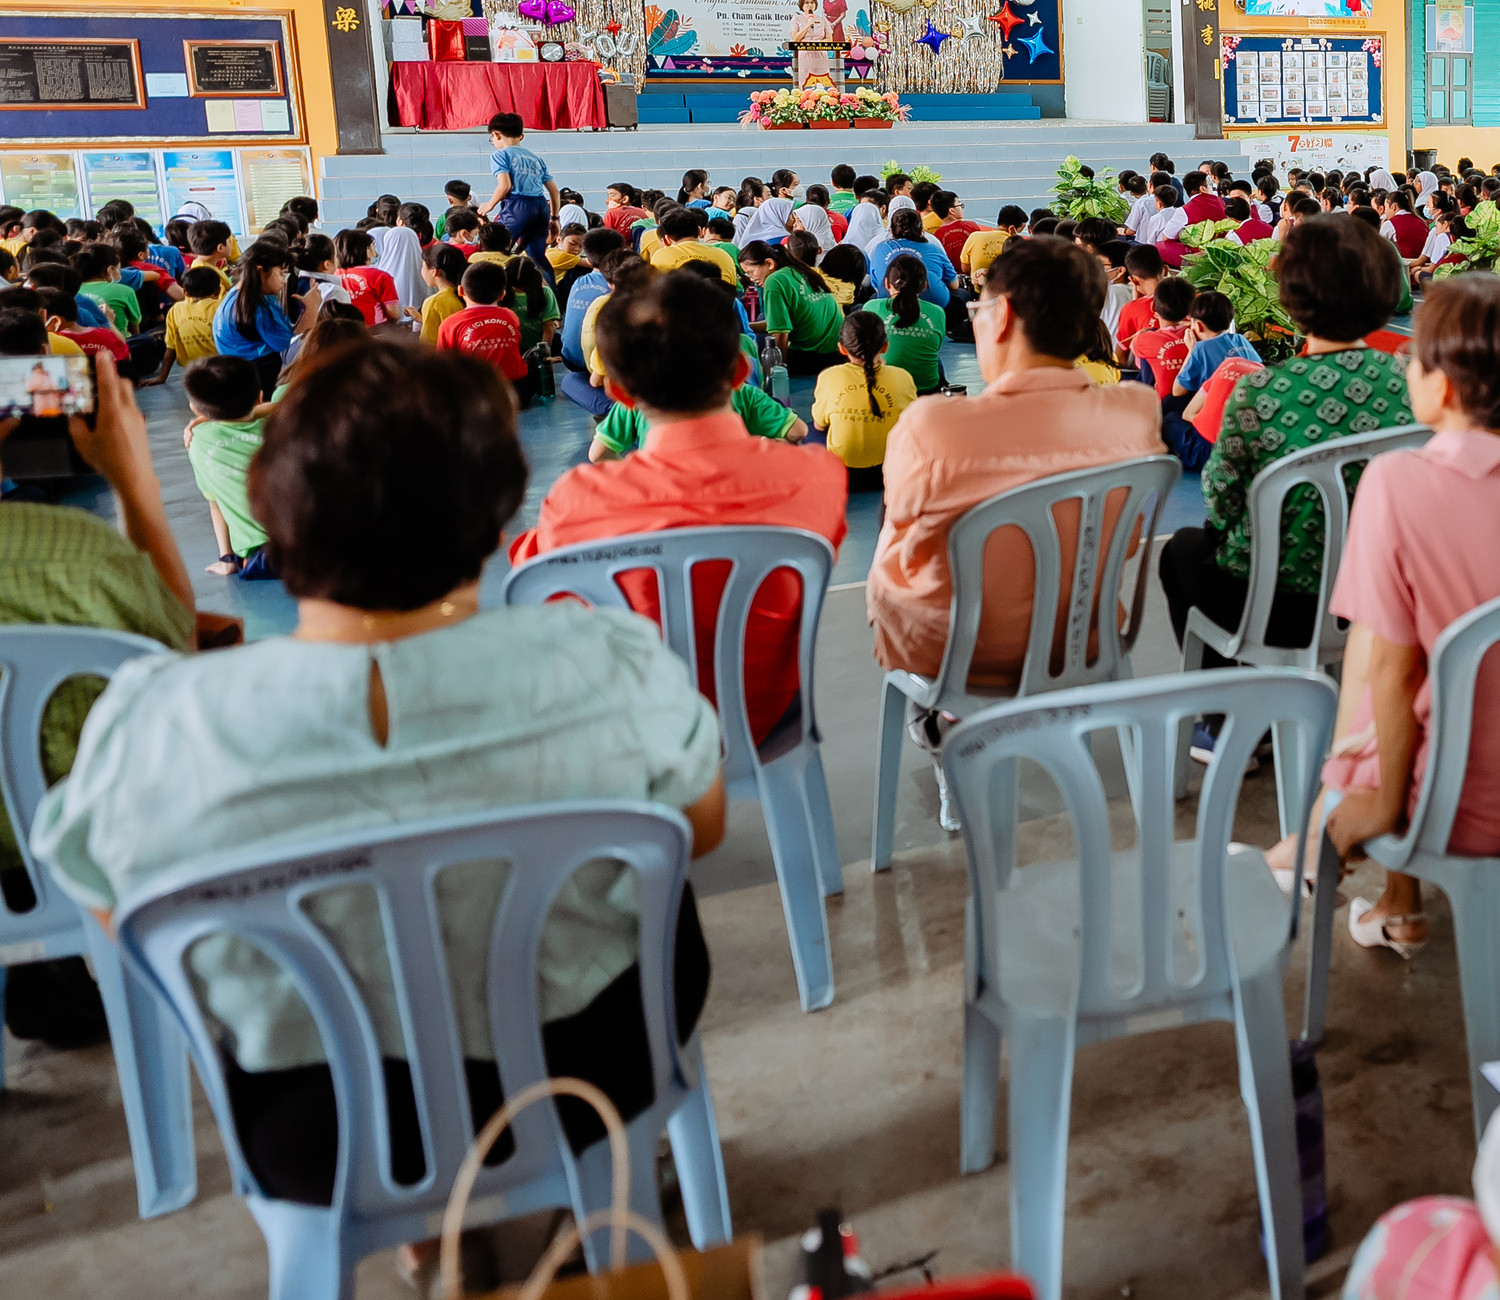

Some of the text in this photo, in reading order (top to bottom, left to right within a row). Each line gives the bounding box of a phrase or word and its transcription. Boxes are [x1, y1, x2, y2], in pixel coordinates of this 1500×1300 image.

[732, 12, 753, 20] Cham
[755, 12, 772, 20] Gaik
[577, 22, 639, 59] YOU
[463, 327, 475, 342] SJK
[484, 318, 508, 327] KONG
[885, 392, 895, 409] MIN
